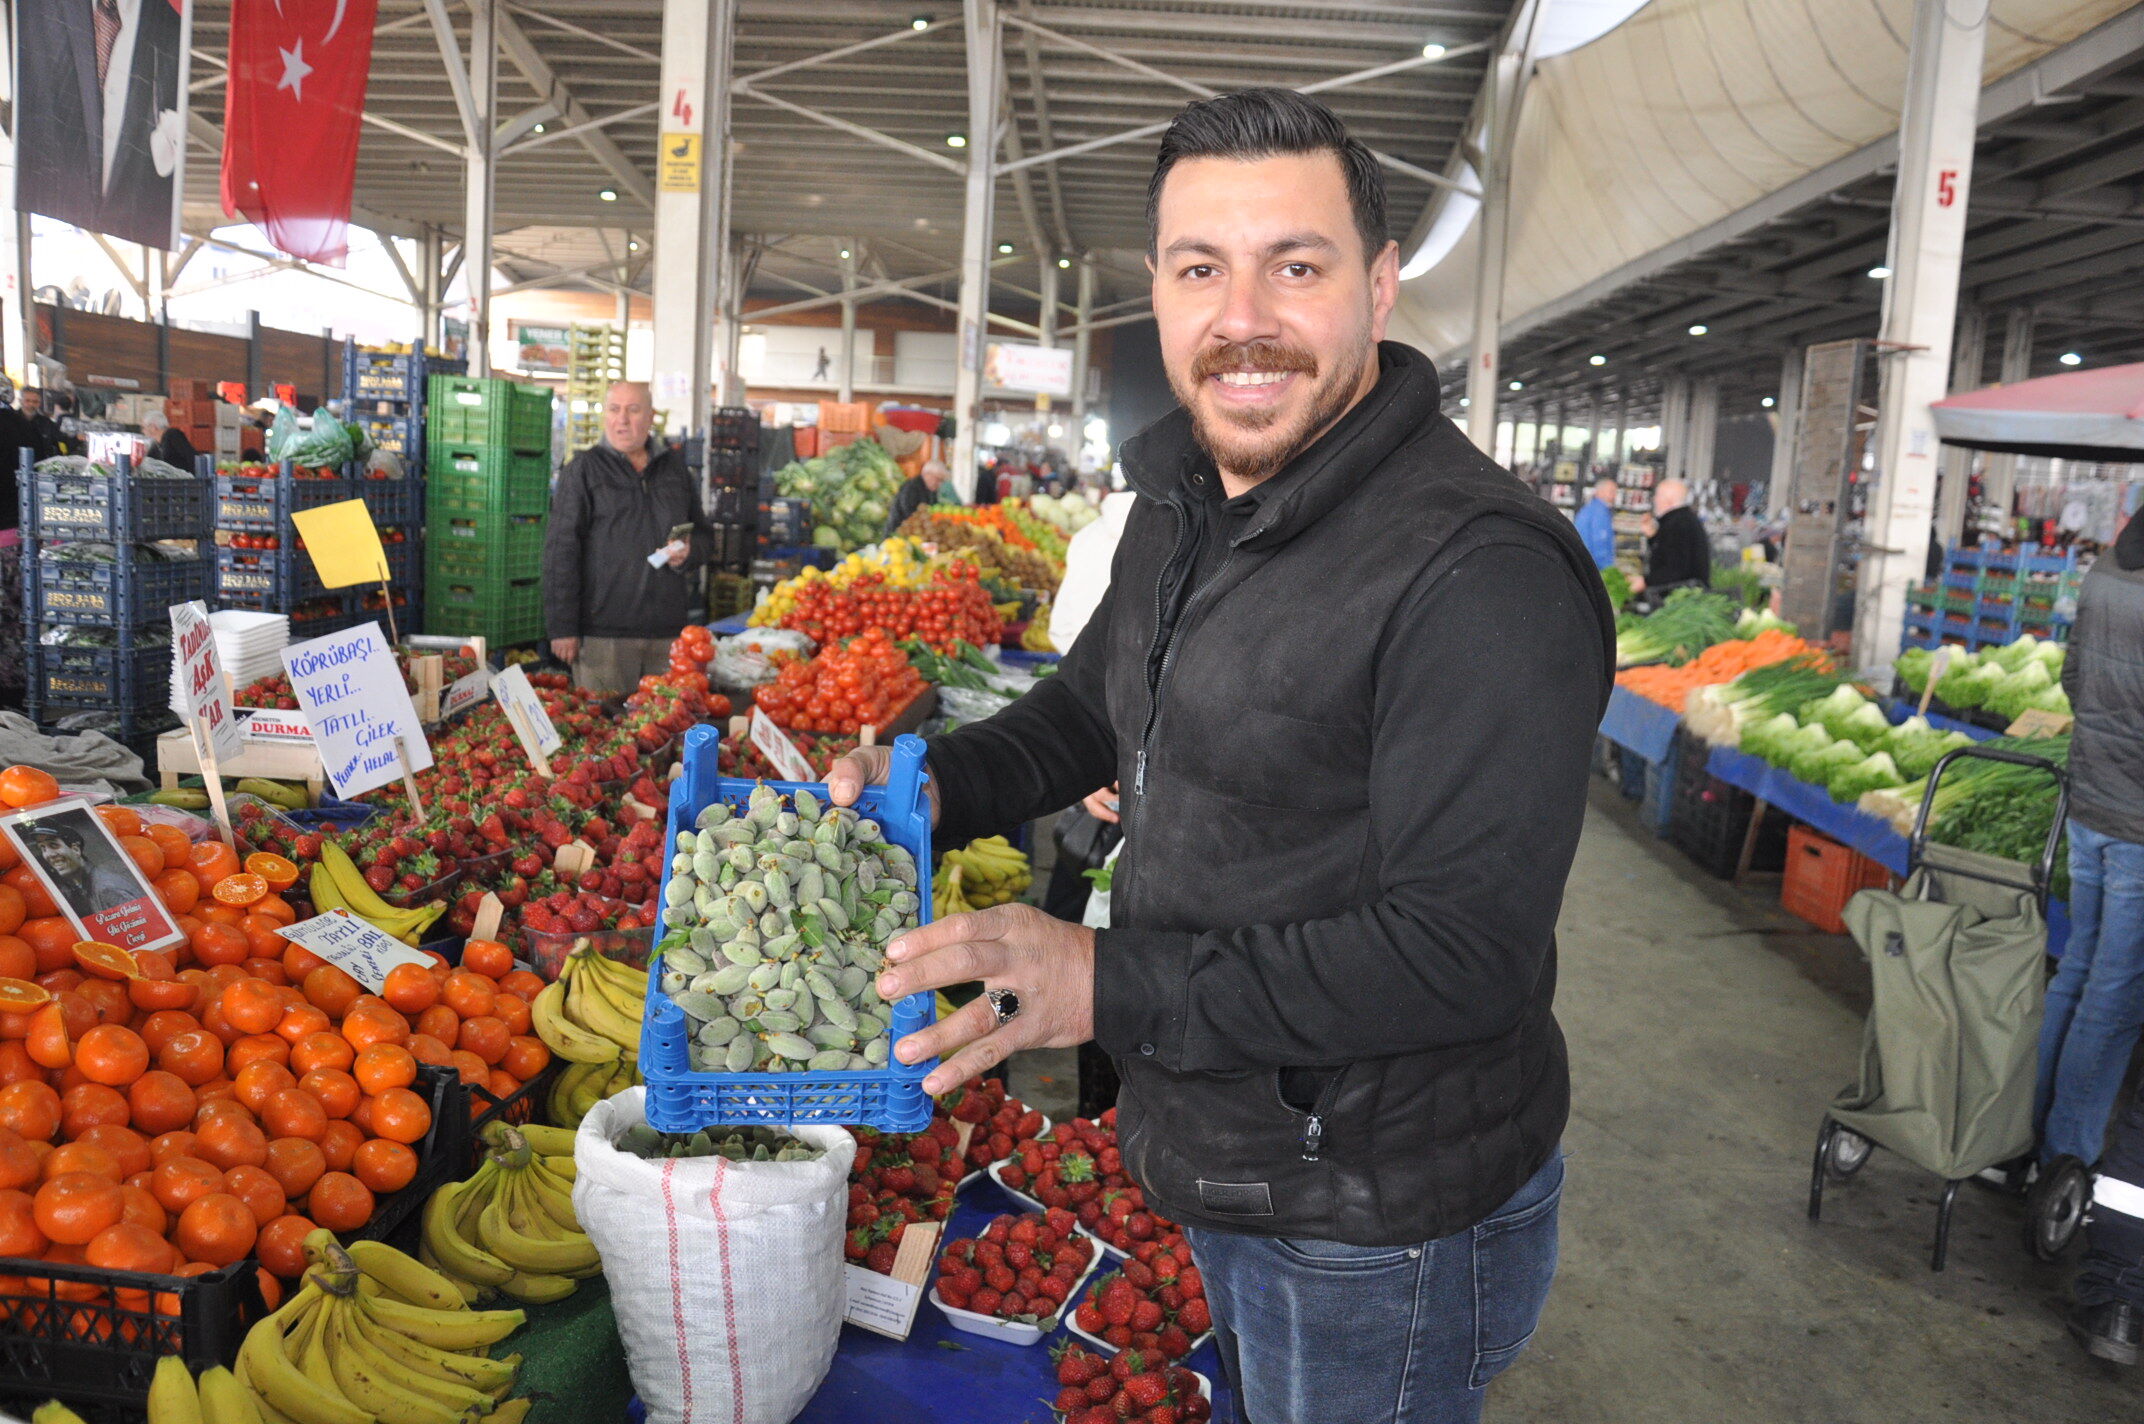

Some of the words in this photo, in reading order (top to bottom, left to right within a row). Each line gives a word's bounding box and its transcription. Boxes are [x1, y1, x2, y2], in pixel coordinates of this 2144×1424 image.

[672, 88, 692, 126] 4
[1938, 170, 1957, 208] 5
[251, 722, 313, 736] DURMA
[357, 930, 385, 950] BAL
